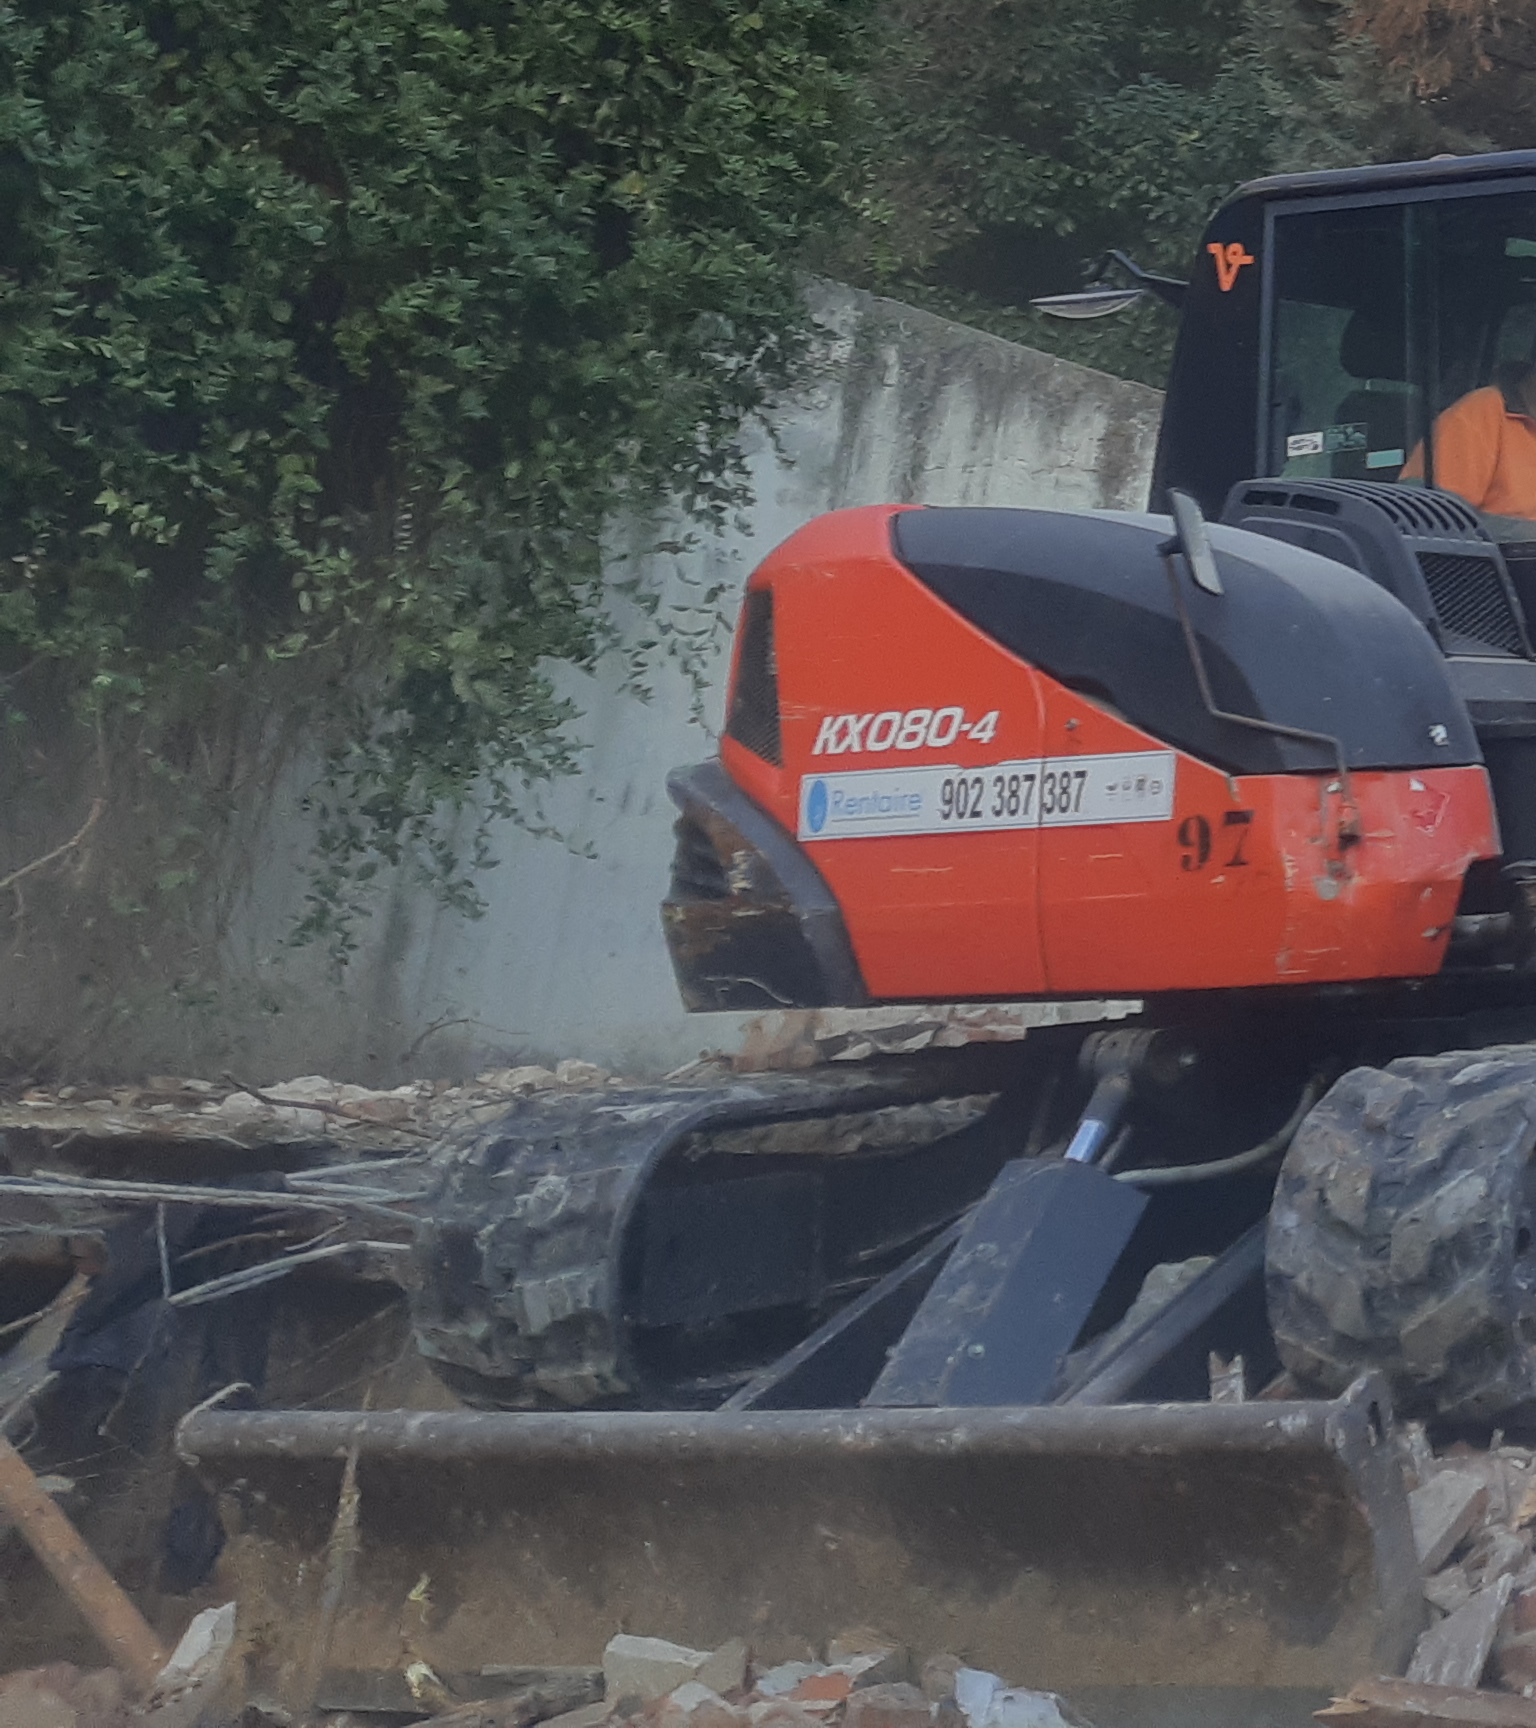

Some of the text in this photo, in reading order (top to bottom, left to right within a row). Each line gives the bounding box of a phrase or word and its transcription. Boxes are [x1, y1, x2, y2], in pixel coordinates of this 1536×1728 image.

[812, 706, 999, 755] KX080-4
[831, 788, 923, 815] Rentaire
[940, 776, 984, 820] 902
[991, 773, 1036, 816] 387
[1042, 769, 1089, 814] 387
[1178, 809, 1256, 872] 97
